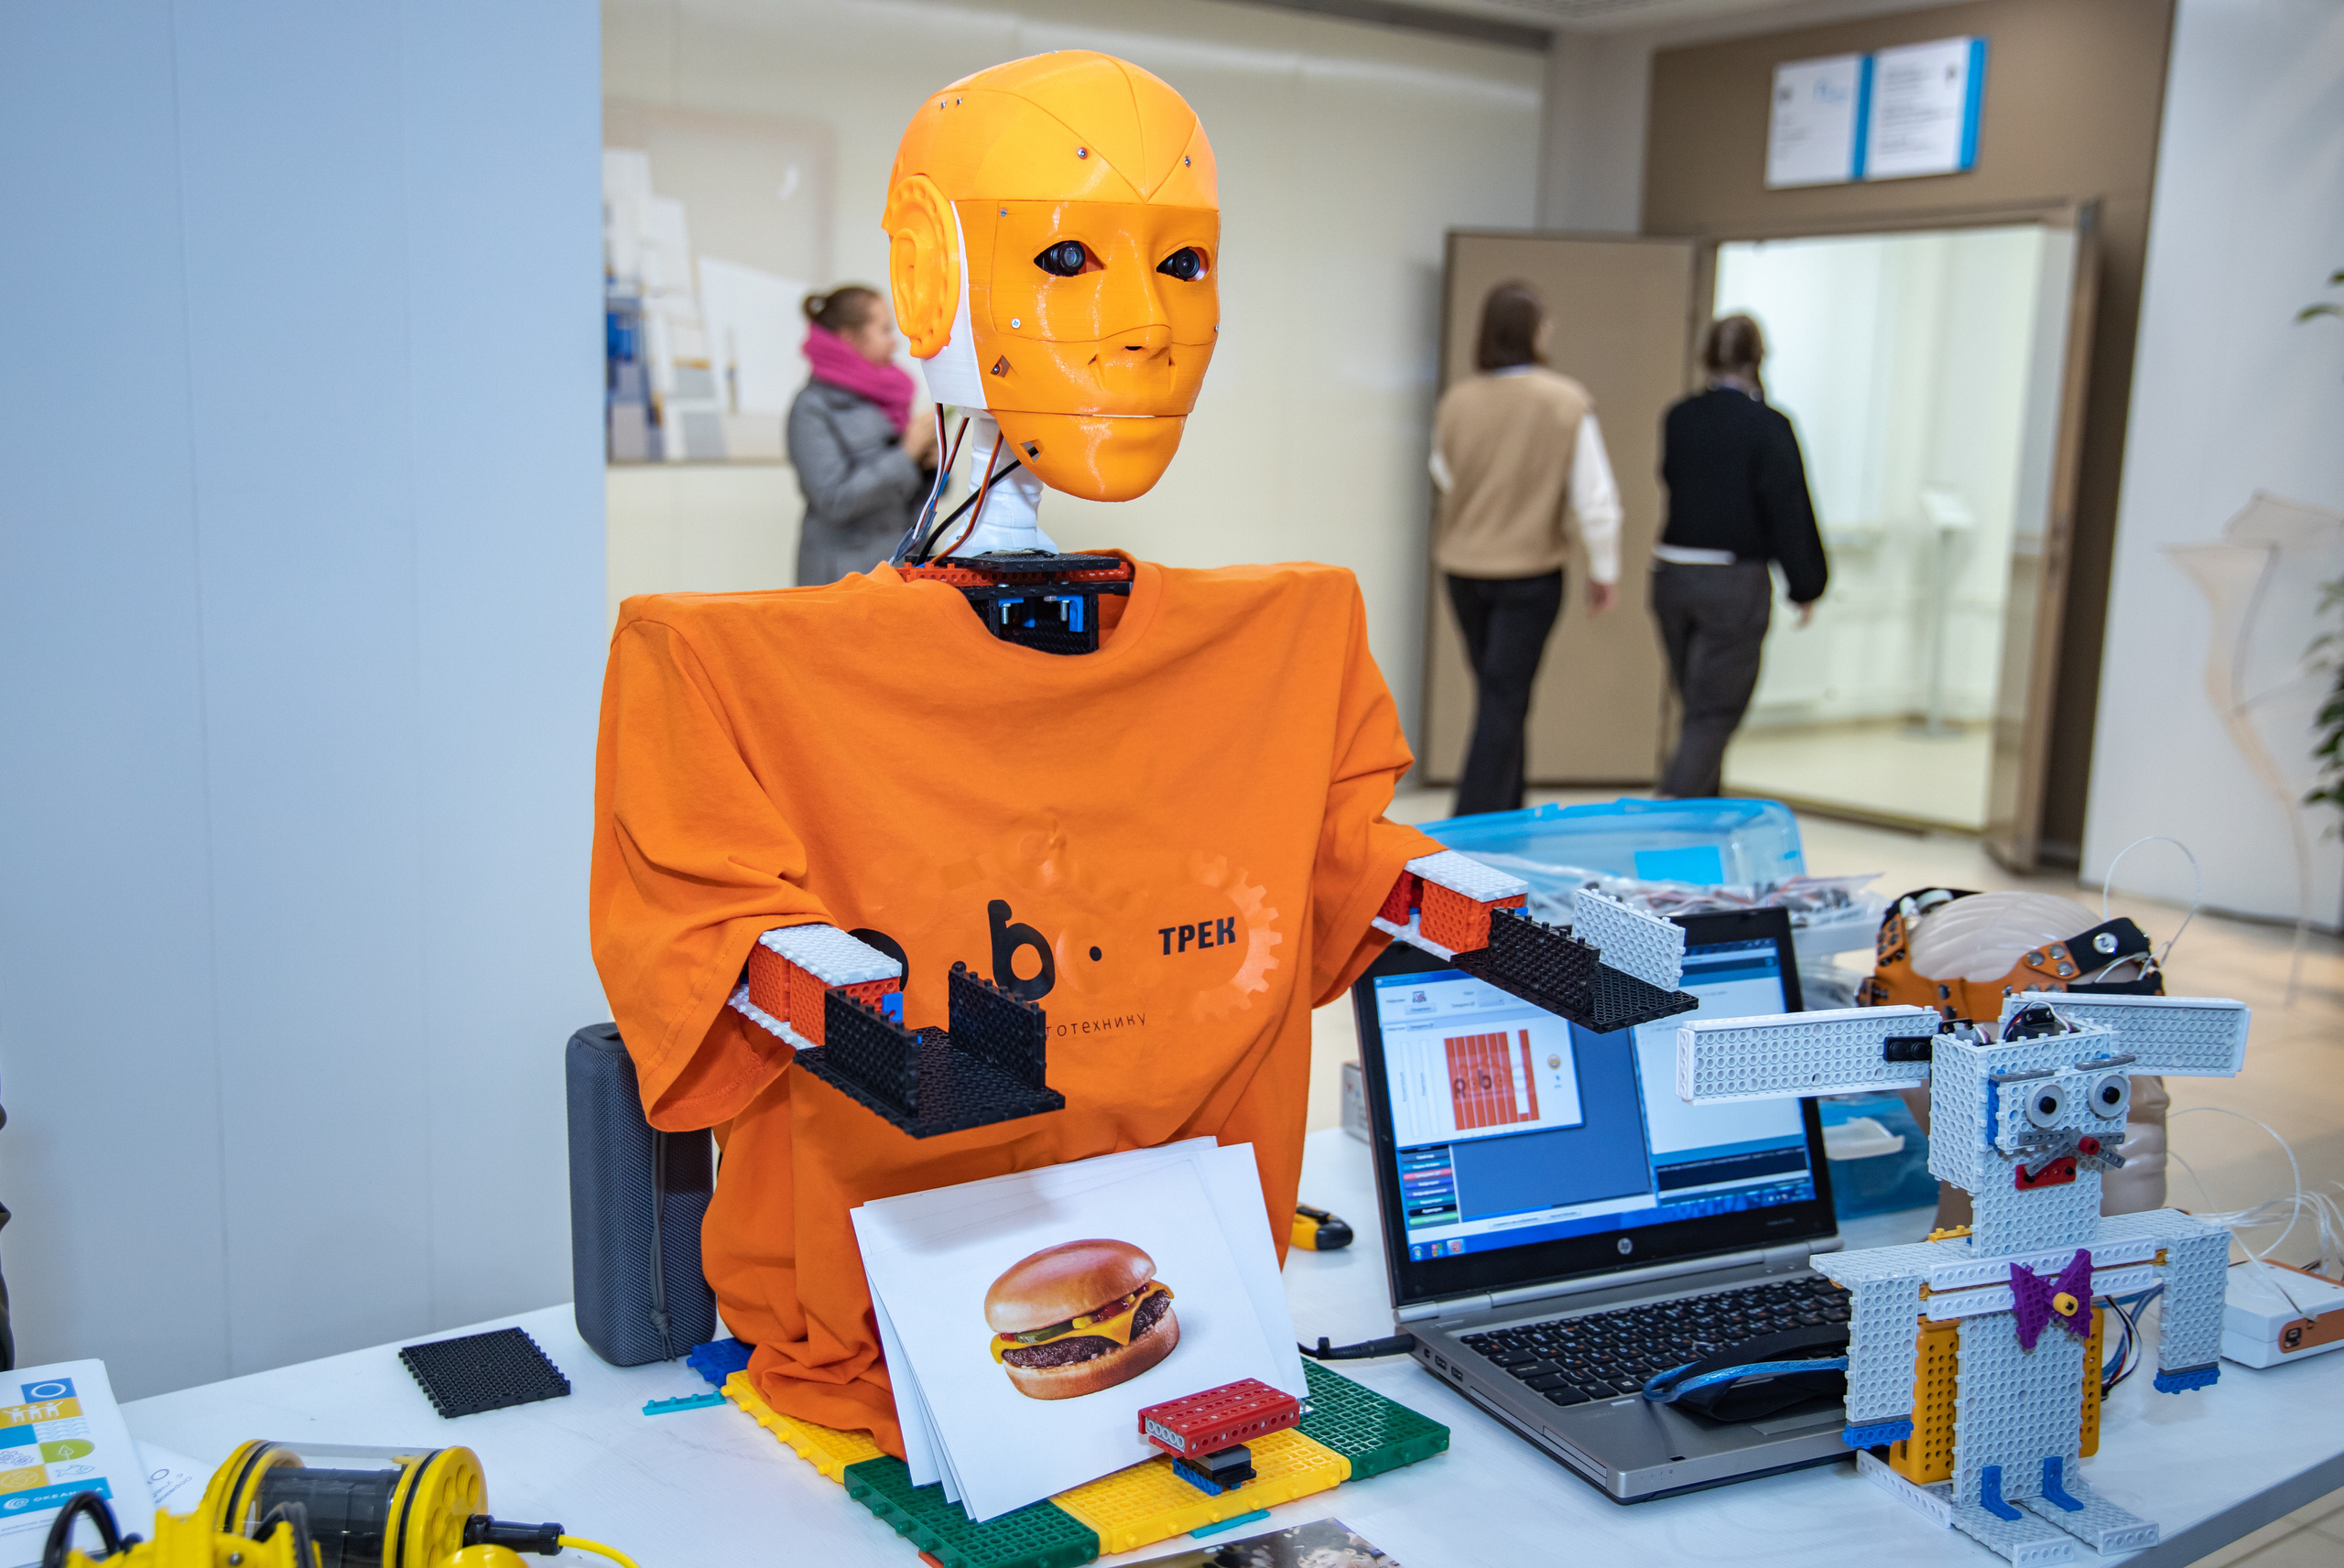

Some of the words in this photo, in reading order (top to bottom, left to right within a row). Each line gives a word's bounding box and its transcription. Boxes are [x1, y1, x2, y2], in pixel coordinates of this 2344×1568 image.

[1157, 916, 1236, 956] ТРЕК
[1045, 1012, 1146, 1038] тотехнику
[1618, 1238, 1632, 1255] hp
[32, 1487, 103, 1503] ОКЕАНА
